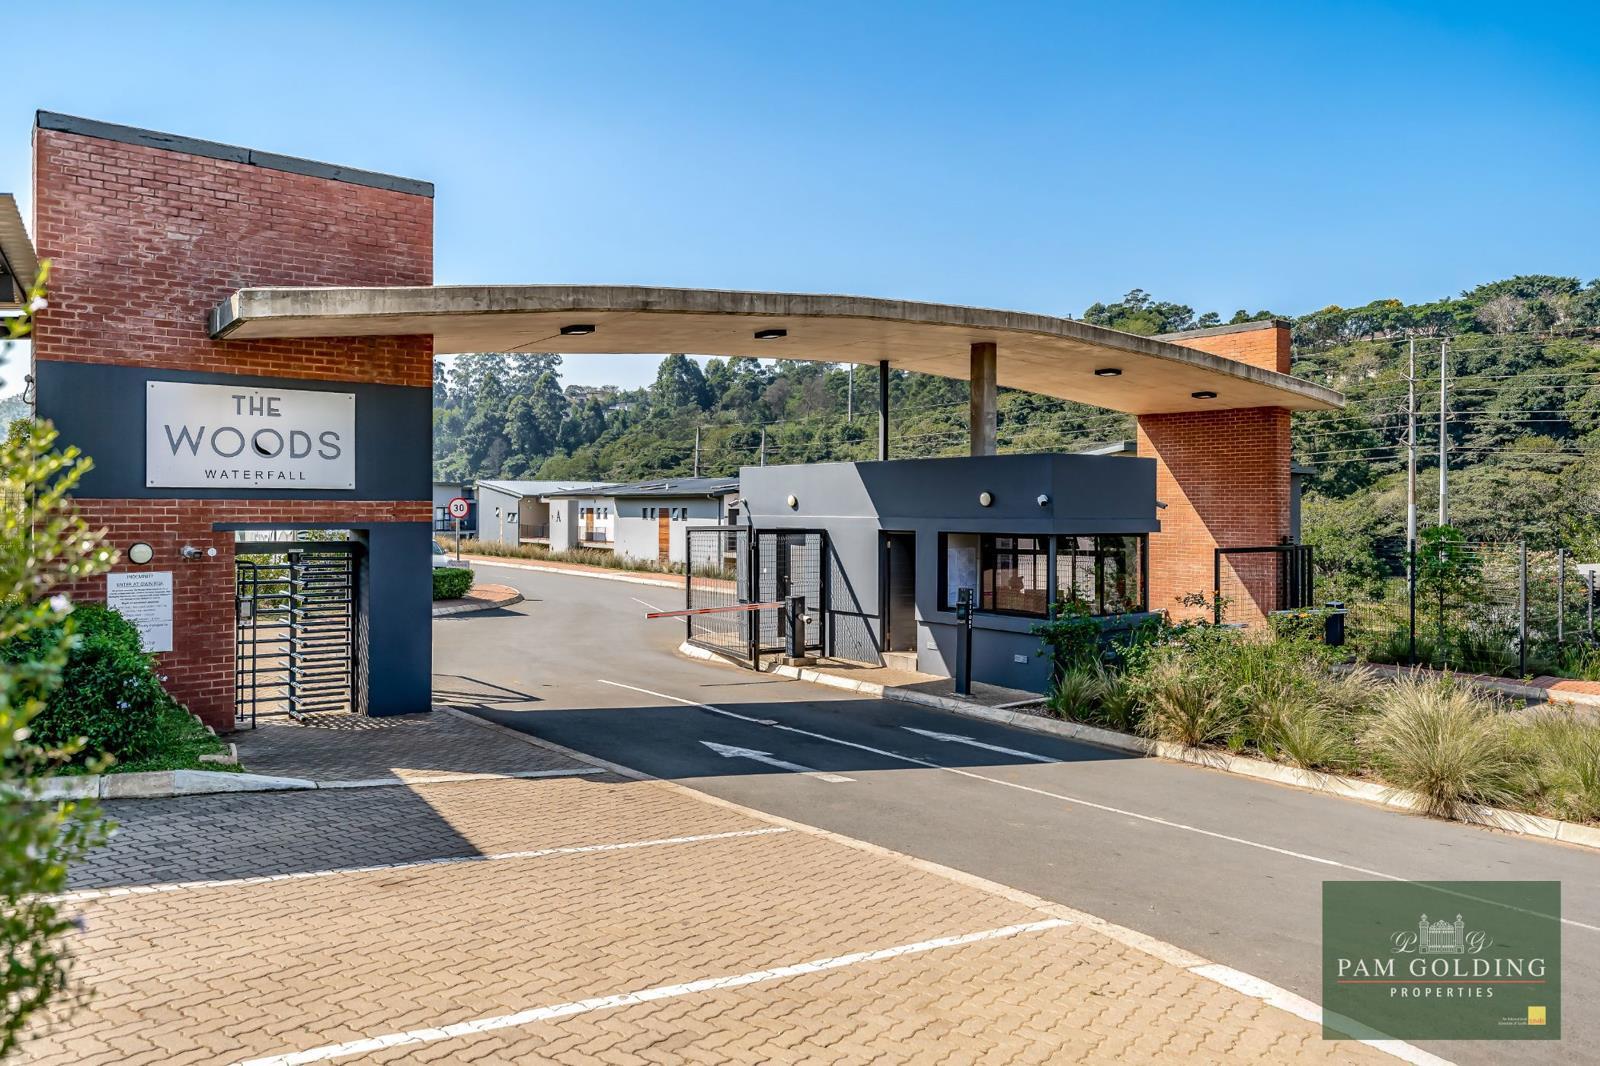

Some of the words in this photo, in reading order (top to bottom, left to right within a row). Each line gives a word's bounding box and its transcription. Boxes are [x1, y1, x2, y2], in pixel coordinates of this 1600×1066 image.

[232, 394, 281, 417] THE
[164, 425, 342, 460] WOODS
[204, 469, 306, 480] WATERFALL
[454, 503, 464, 512] 30
